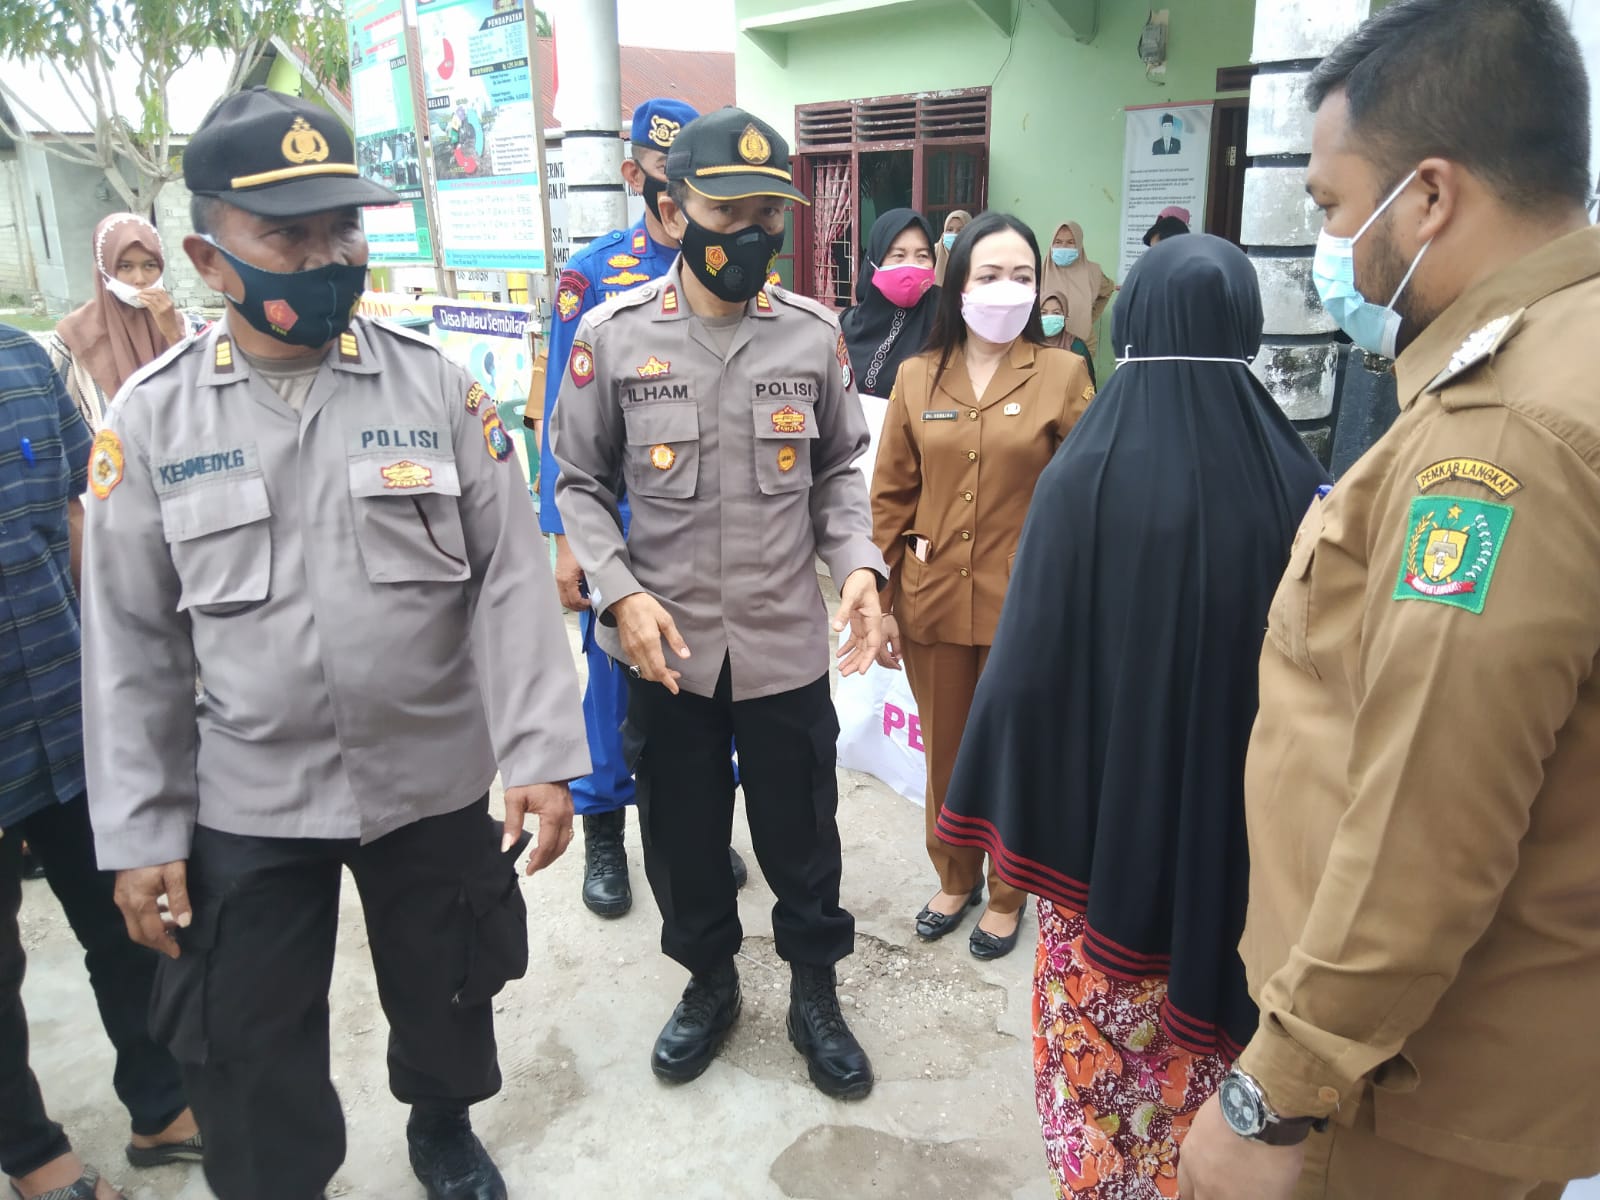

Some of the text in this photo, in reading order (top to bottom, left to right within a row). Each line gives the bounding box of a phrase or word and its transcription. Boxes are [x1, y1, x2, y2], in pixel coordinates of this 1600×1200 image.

[487, 12, 523, 28] PENDAPATAN
[440, 309, 526, 334] Desa Pulau Sembilan
[627, 384, 689, 402] ILHAM
[755, 382, 812, 397] POLISI
[361, 429, 439, 449] POLISI
[1420, 460, 1515, 496] PEMKAB LANGKAT
